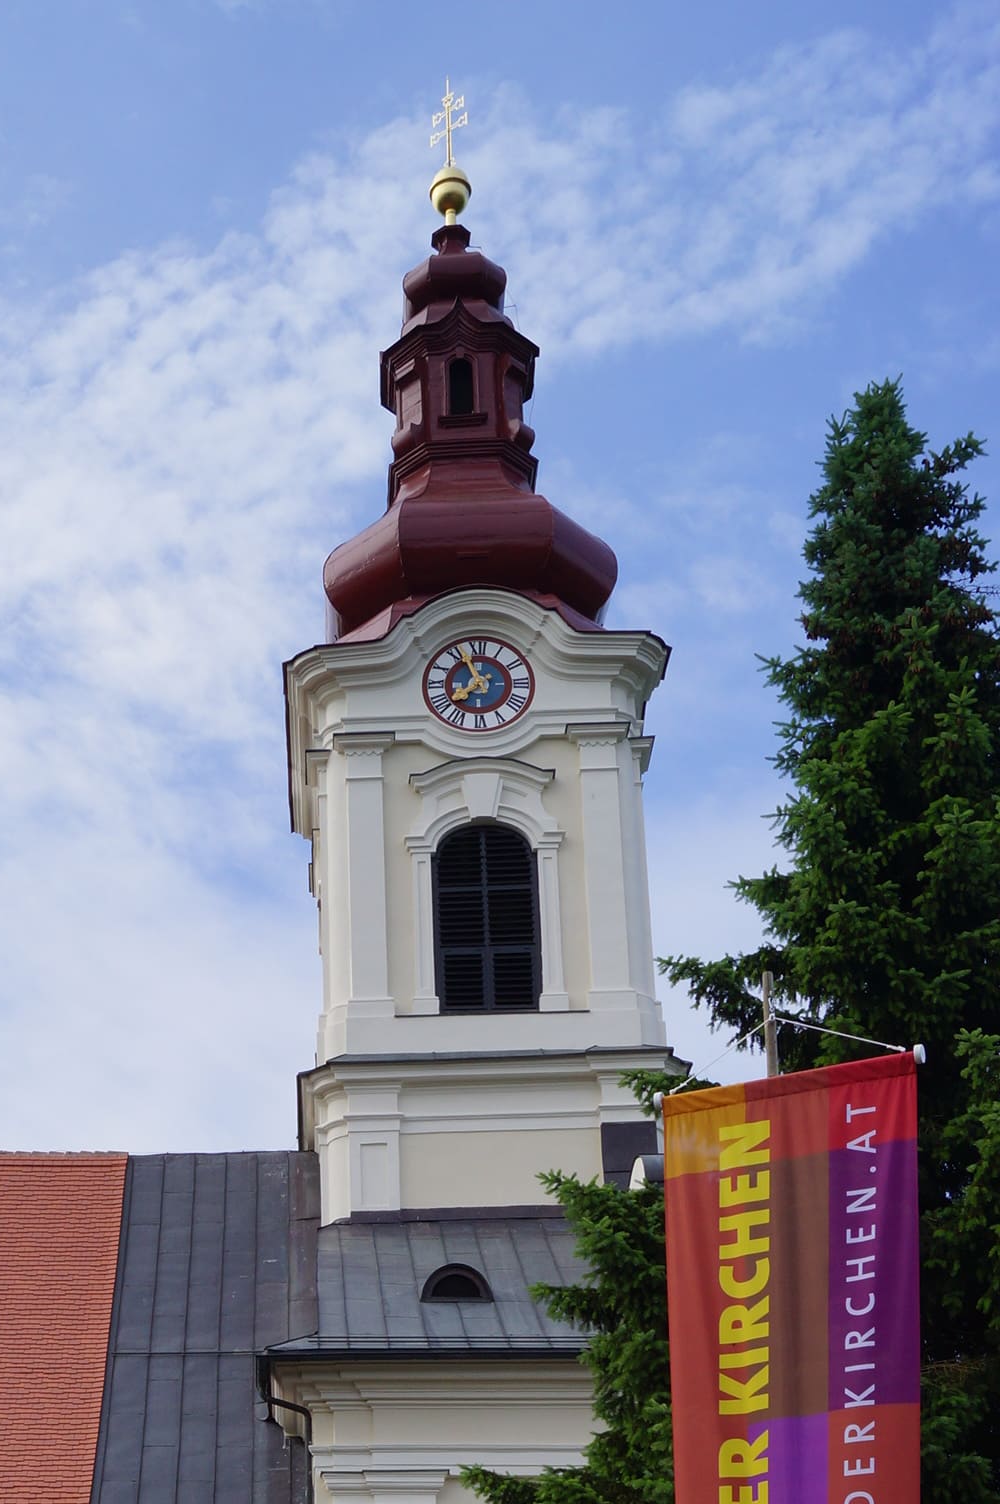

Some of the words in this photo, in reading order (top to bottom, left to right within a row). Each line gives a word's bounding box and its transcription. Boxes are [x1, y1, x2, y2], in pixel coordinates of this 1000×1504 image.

[446, 645, 463, 663] XI
[469, 641, 487, 655] XII
[494, 646, 504, 659] I
[433, 662, 450, 674] X
[506, 658, 523, 671] II
[428, 679, 444, 689] IX
[513, 677, 529, 689] III
[430, 693, 452, 714] VIII
[506, 693, 527, 713] IIII
[447, 708, 466, 726] VII
[474, 714, 487, 728] VI
[494, 710, 506, 724] V
[718, 1119, 771, 1416] KIRCHEN
